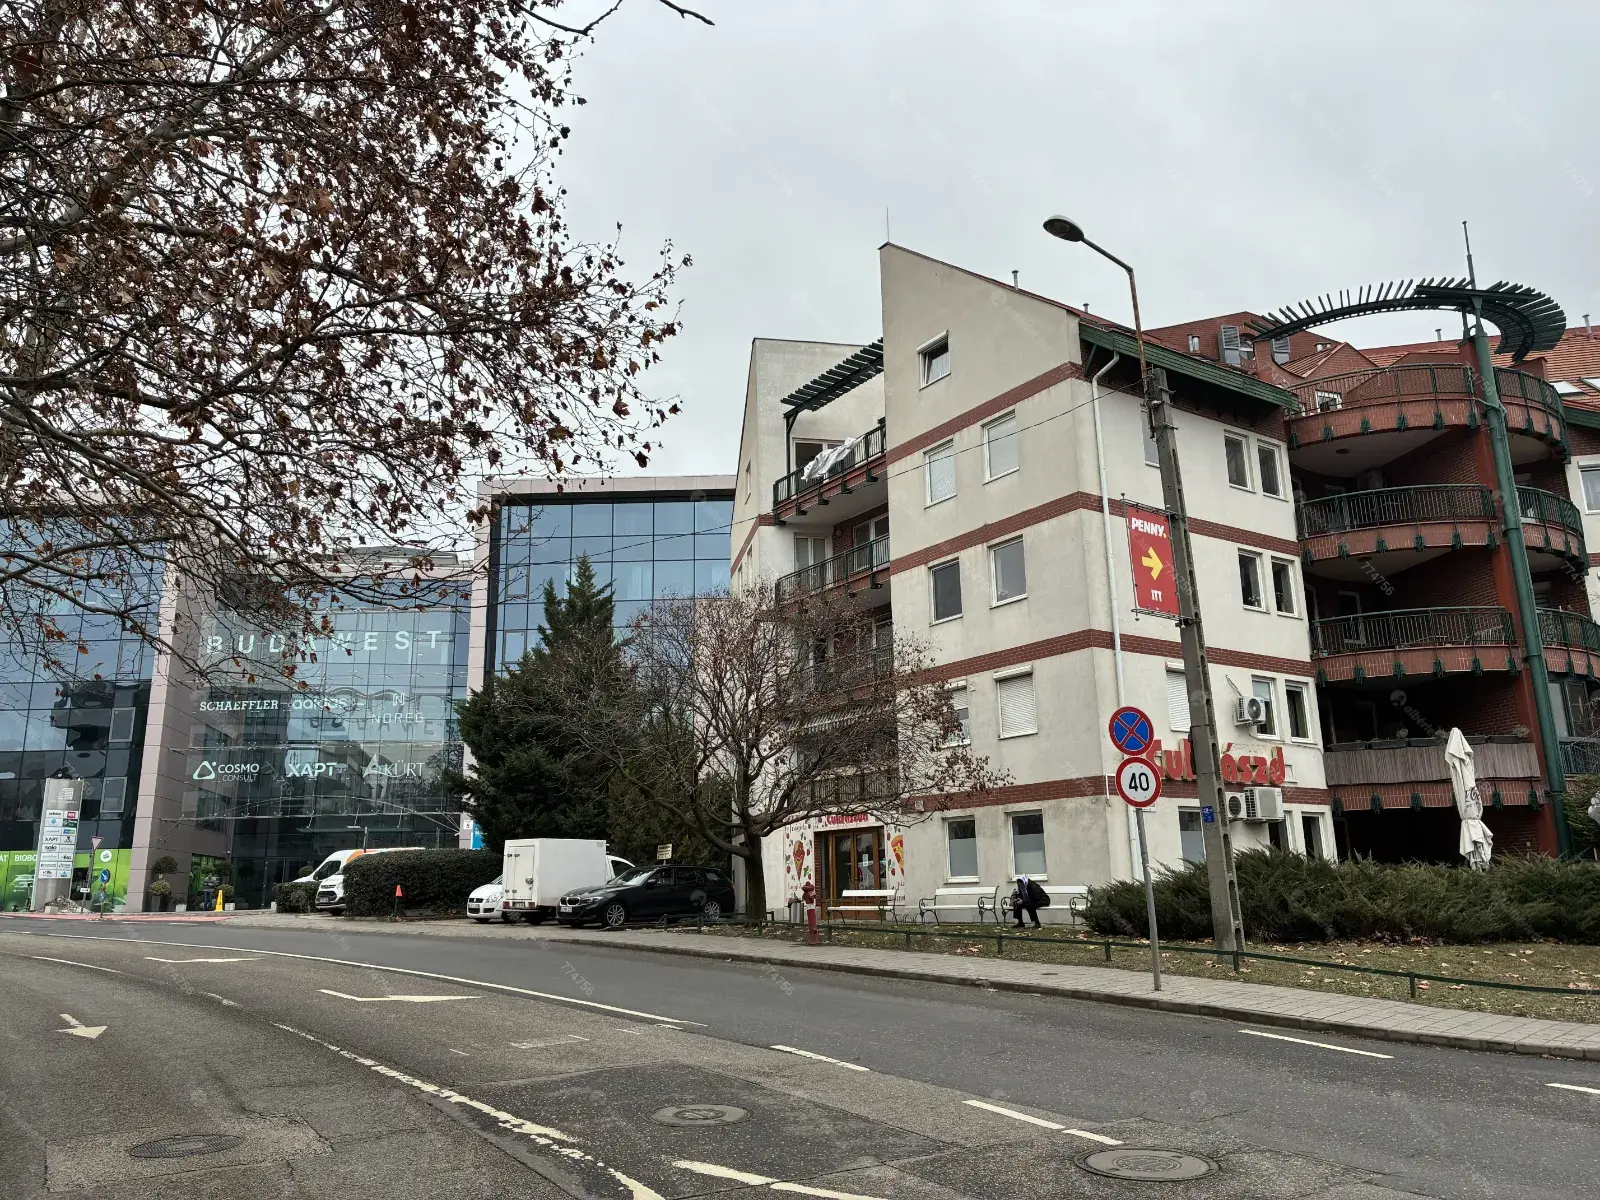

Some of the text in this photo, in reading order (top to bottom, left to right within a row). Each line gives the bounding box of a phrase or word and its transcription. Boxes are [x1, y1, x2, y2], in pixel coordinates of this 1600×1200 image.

[1150, 588, 1163, 602] ITT
[199, 699, 279, 711] SCHAEFFLER
[371, 712, 424, 724] NOREG
[218, 763, 260, 774] COSMO
[286, 761, 337, 778] XAPT
[384, 759, 426, 777] KÜRT
[222, 773, 257, 782] CONSULT
[1128, 772, 1150, 792] 40
